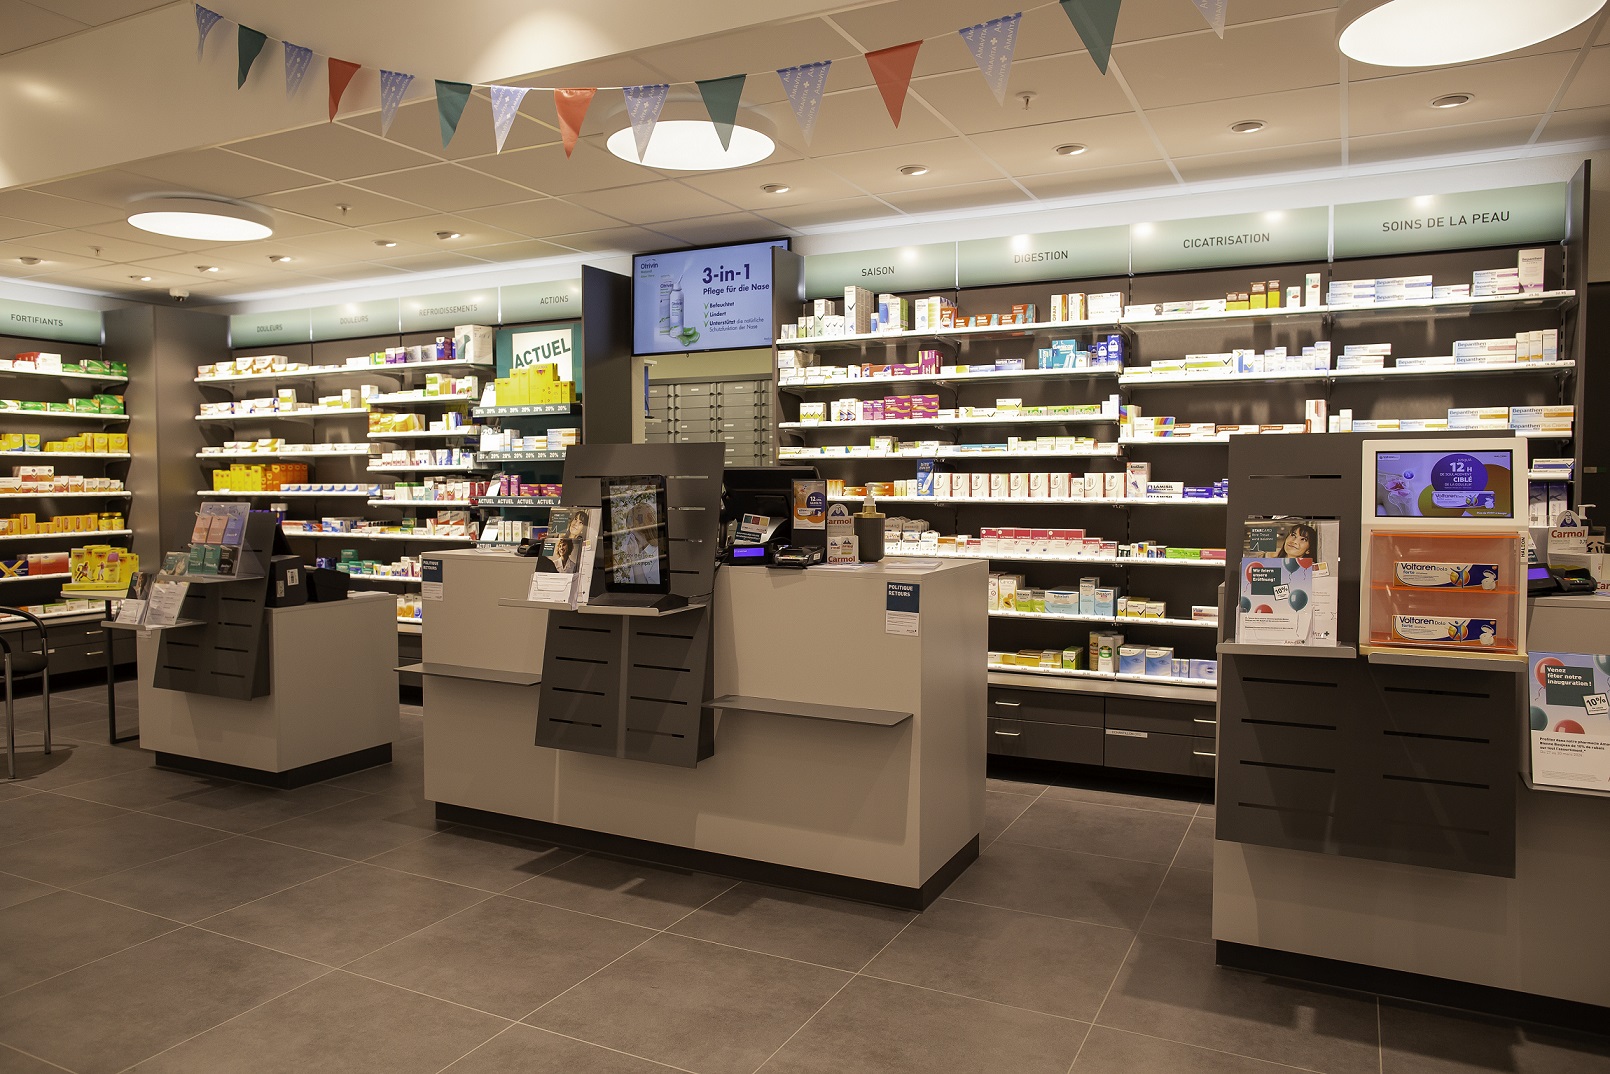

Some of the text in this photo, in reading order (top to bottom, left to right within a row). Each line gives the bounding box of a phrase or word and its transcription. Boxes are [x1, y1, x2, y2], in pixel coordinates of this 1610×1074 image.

[1004, 20, 1016, 50] AMAVITA
[976, 28, 988, 58] AMAVITA
[985, 46, 997, 76] AMAVITA
[790, 71, 802, 100] AMAVITA
[814, 66, 827, 94] AMAVITA
[796, 89, 808, 117] AMAVITA
[1382, 210, 1510, 232] SOINS DE LA PEAU
[1182, 232, 1270, 250] CICATRISATION
[1014, 250, 1068, 264] DIGESTION
[702, 263, 750, 284] 3-in-1
[861, 266, 895, 277] SAISON
[703, 283, 770, 296] Pflege für die Nase
[540, 295, 568, 305] ACTIONS
[418, 304, 478, 317] REFROIDISSEMENTS
[10, 314, 64, 326] FORTIFIANTS
[340, 315, 369, 325] DOULEURS
[256, 324, 283, 333] DOULEURS
[514, 338, 571, 369] ACTUEL
[1450, 462, 1464, 472] 12
[1551, 530, 1585, 539] Carmol
[1400, 562, 1436, 571] Voltaren
[1275, 586, 1288, 595] 10%
[1400, 617, 1435, 625] Voltaren
[1586, 696, 1607, 707] 10%
